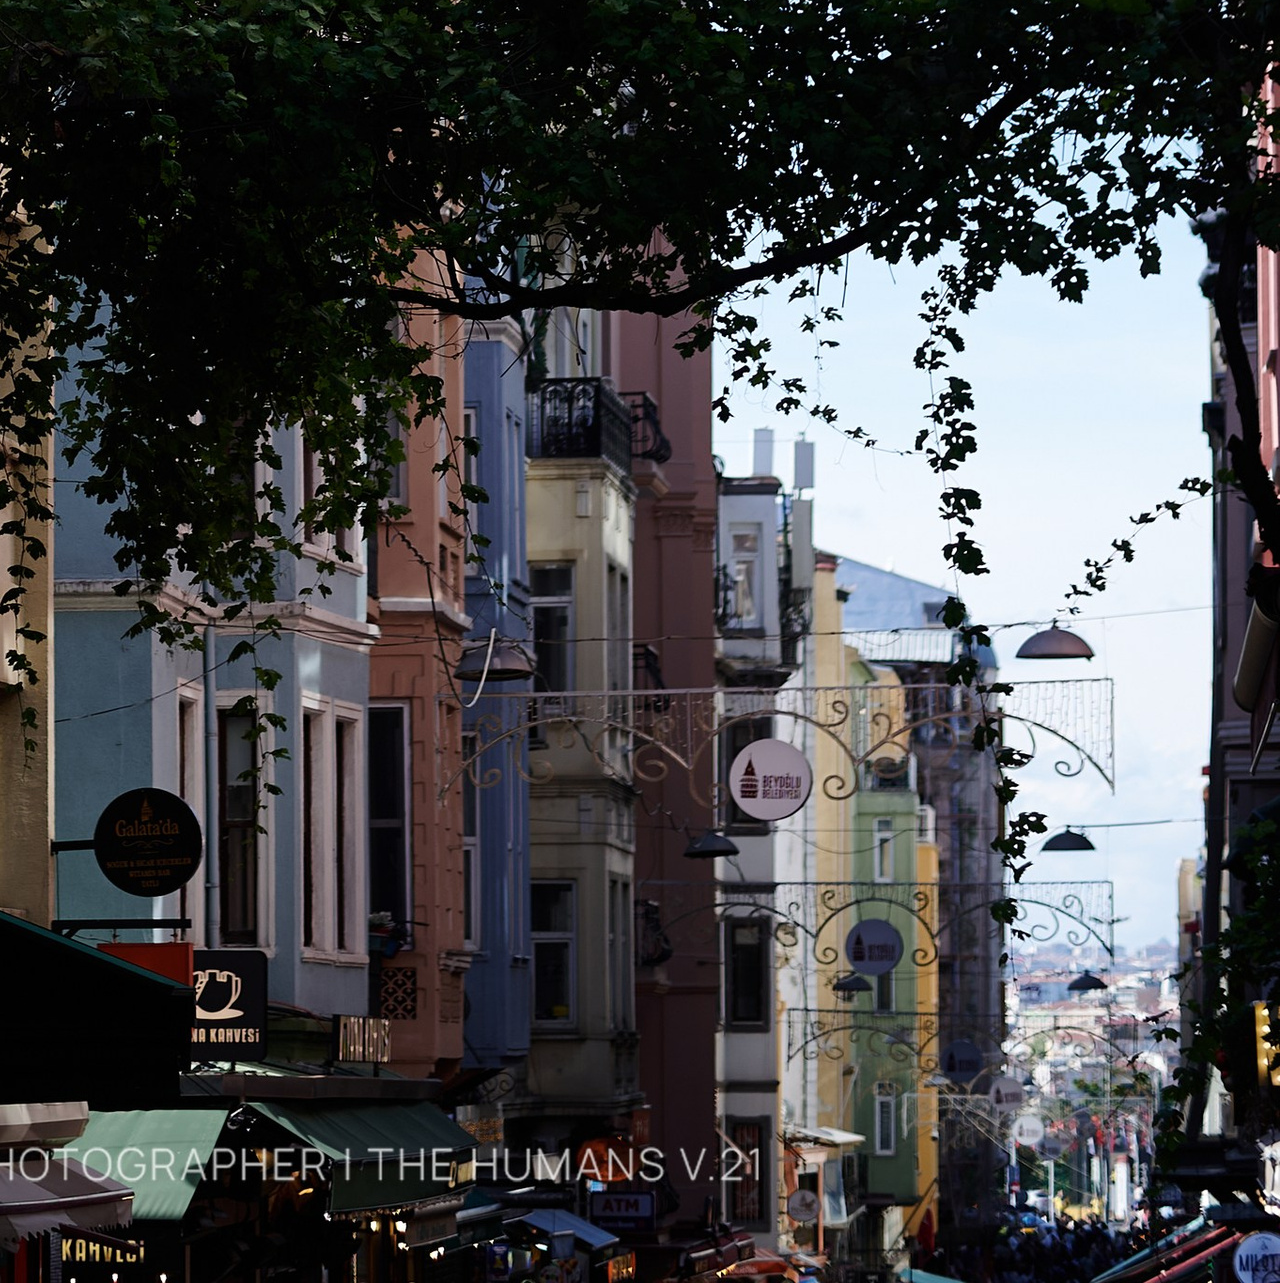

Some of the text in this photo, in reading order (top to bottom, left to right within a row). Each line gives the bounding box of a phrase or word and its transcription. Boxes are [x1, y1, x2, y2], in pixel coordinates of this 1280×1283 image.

[763, 772, 802, 789] BEYOĞLU
[113, 818, 180, 838] Galata'da
[602, 1198, 640, 1212] ATM
